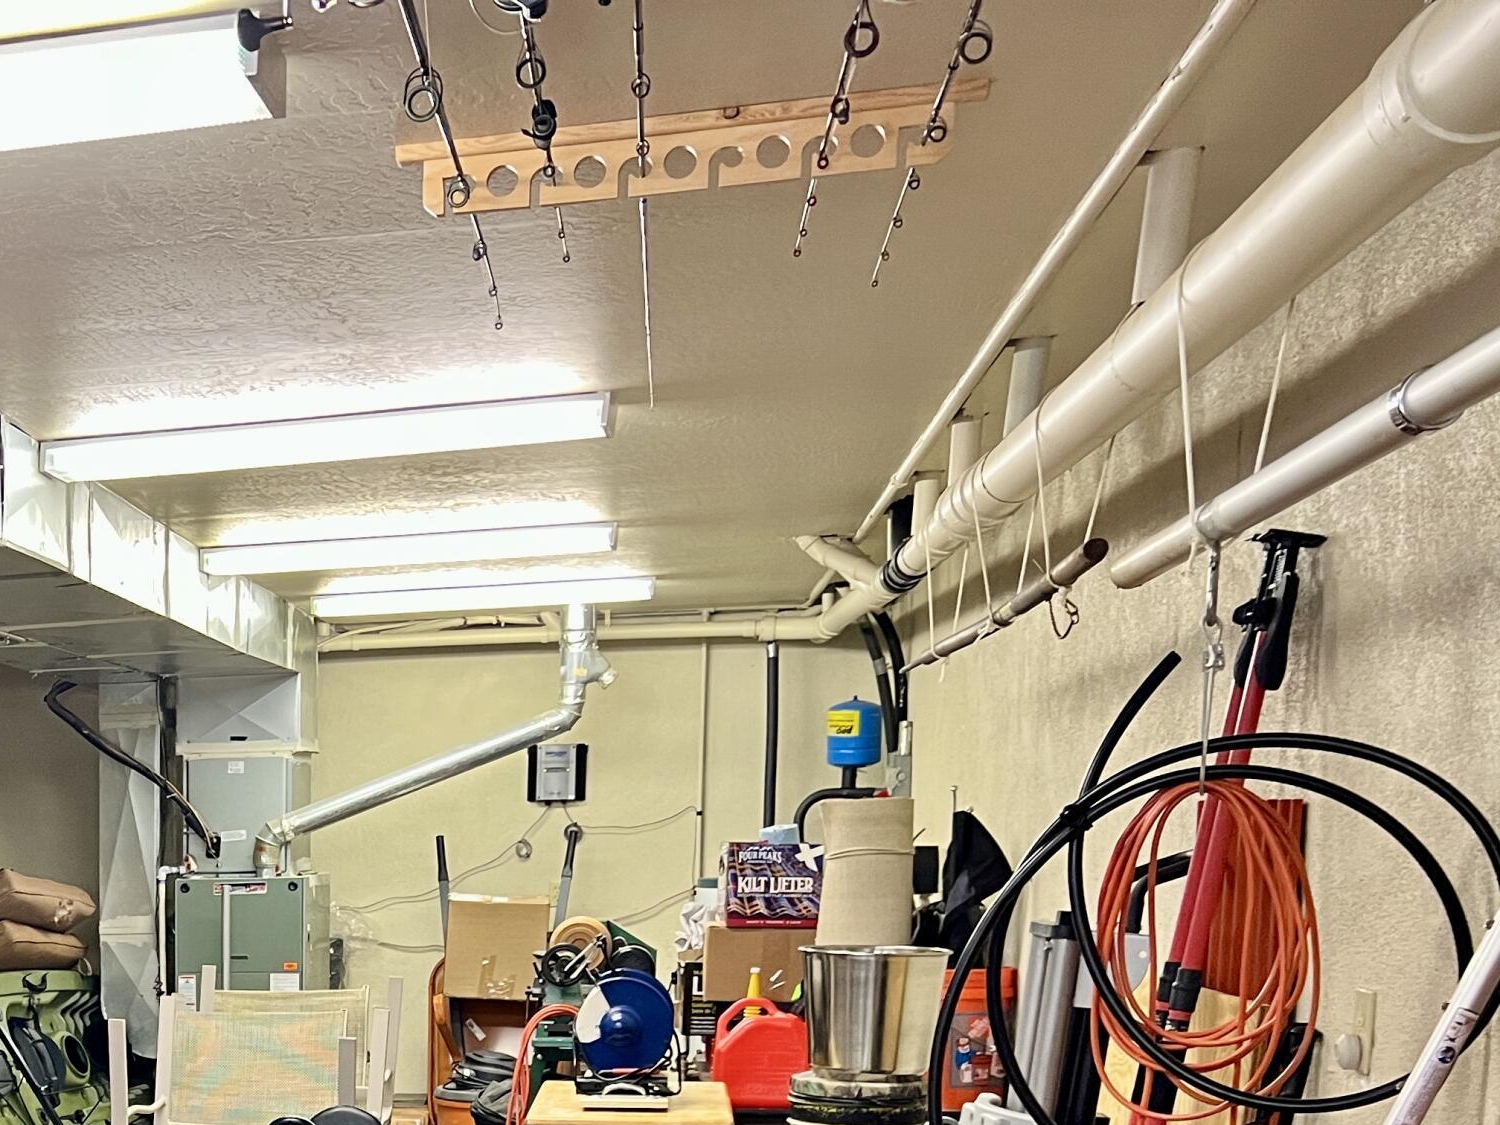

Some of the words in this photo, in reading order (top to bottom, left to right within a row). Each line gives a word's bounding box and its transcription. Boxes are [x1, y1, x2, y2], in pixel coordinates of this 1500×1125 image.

[739, 850, 758, 863] FOUR
[759, 850, 782, 864] PEAKS
[737, 876, 768, 893] KILT
[769, 876, 814, 894] LIFTER
